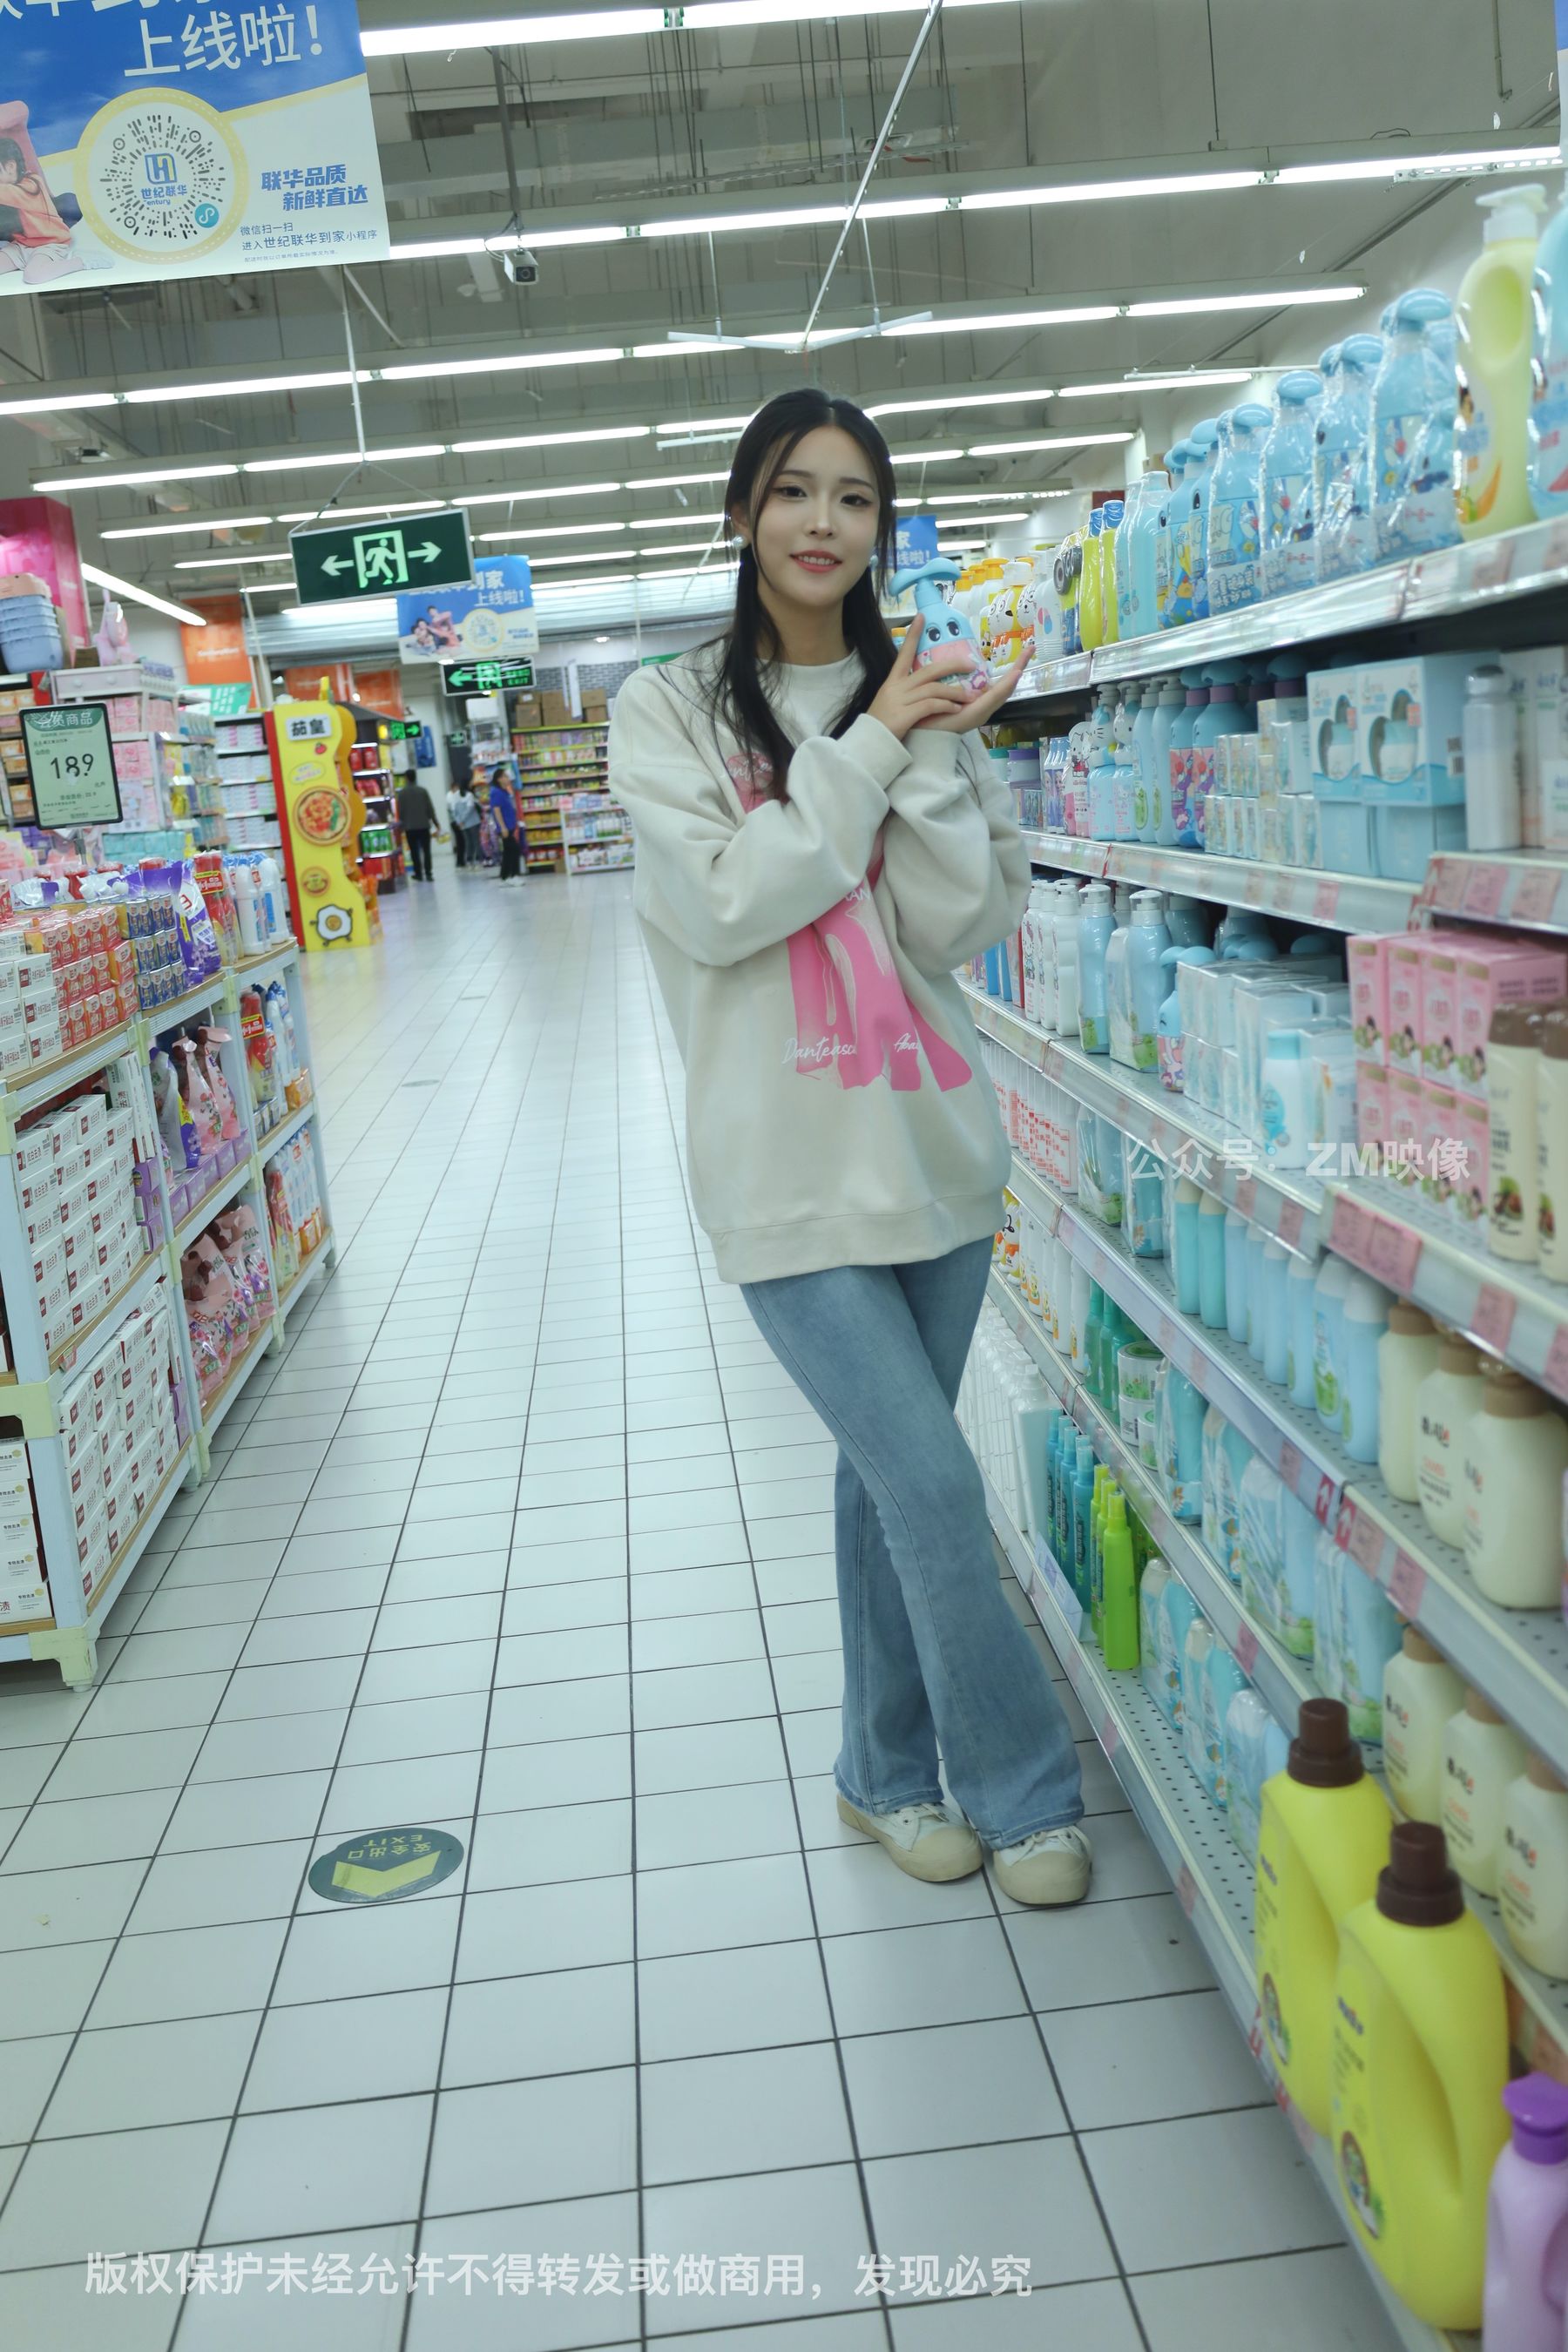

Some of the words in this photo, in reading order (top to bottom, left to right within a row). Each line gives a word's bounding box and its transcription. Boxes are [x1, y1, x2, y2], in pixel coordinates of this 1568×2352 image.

[262, 165, 346, 191] 联华品质
[141, 185, 188, 199] 世纪联华
[283, 185, 368, 212] 新鲜直达
[240, 222, 294, 236] 微信扫一扫
[242, 229, 377, 251] 进入世纪联华到家小程序
[348, 1841, 432, 1860] 安全出口
[363, 1834, 423, 1848] EXIT
